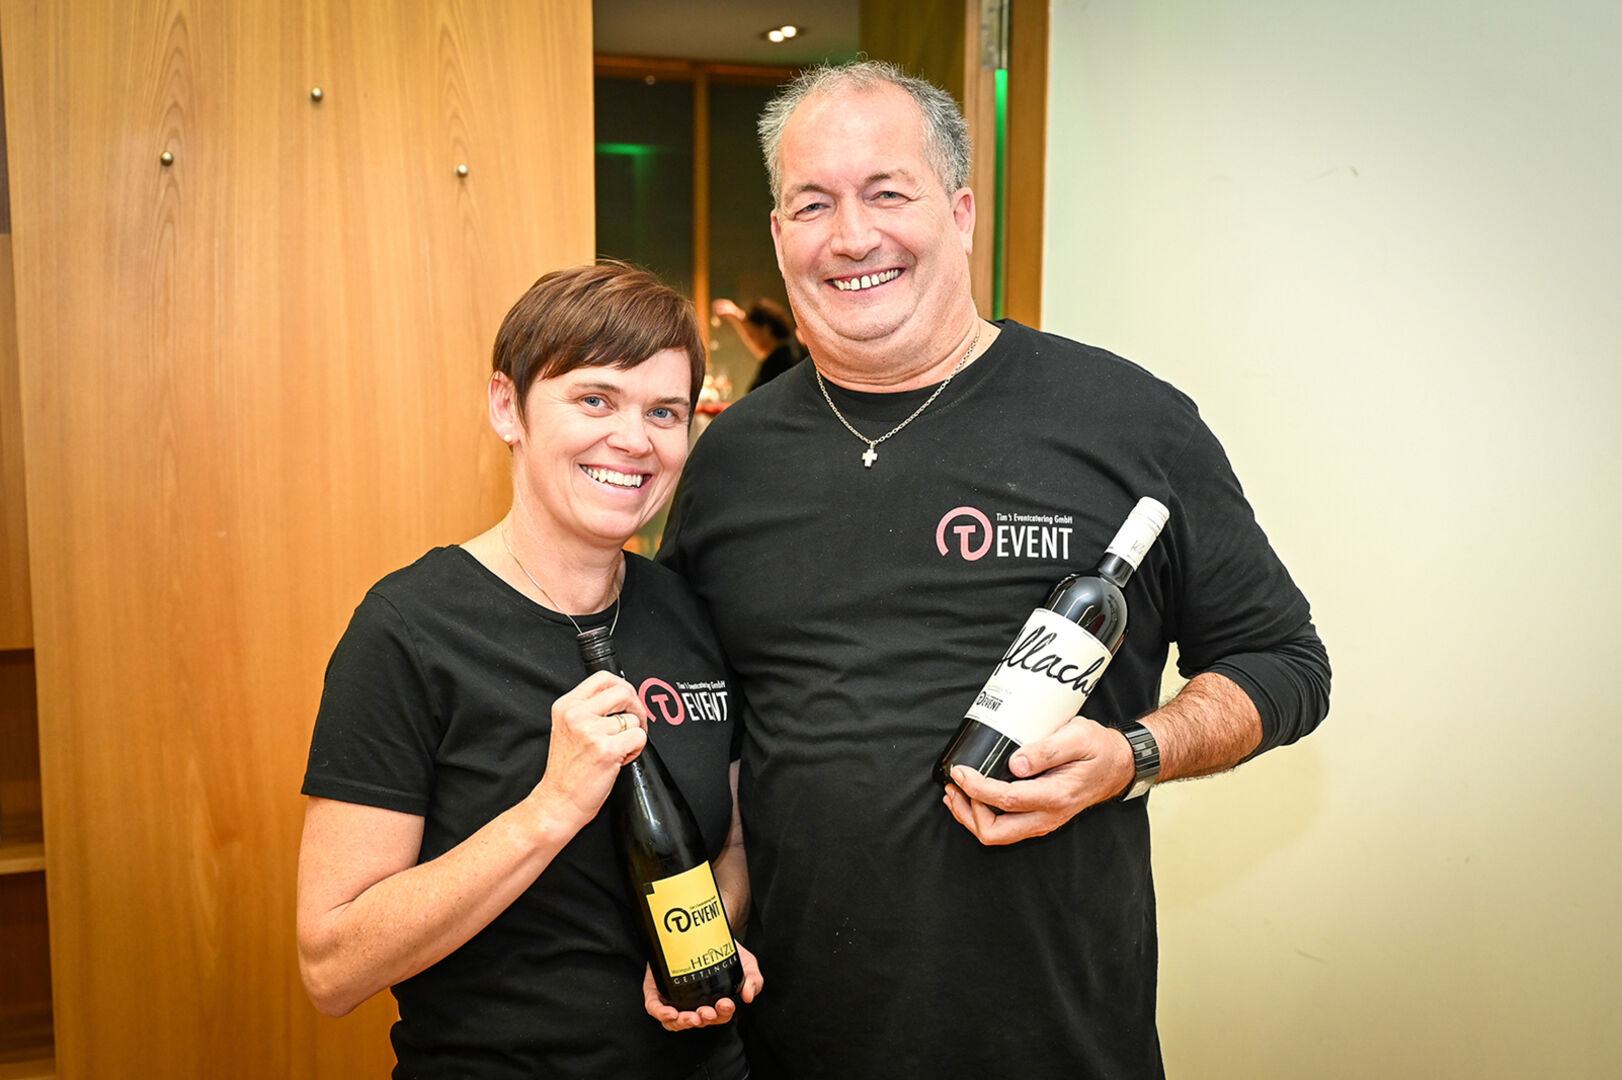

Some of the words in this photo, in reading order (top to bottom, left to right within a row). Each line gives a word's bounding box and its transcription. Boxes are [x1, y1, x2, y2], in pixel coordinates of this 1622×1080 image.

[1013, 512, 1053, 525] Eventcatering
[1054, 514, 1073, 524] GmbH
[996, 525, 1073, 560] EVENT
[681, 691, 728, 721] EVENT
[691, 900, 720, 927] EVENT
